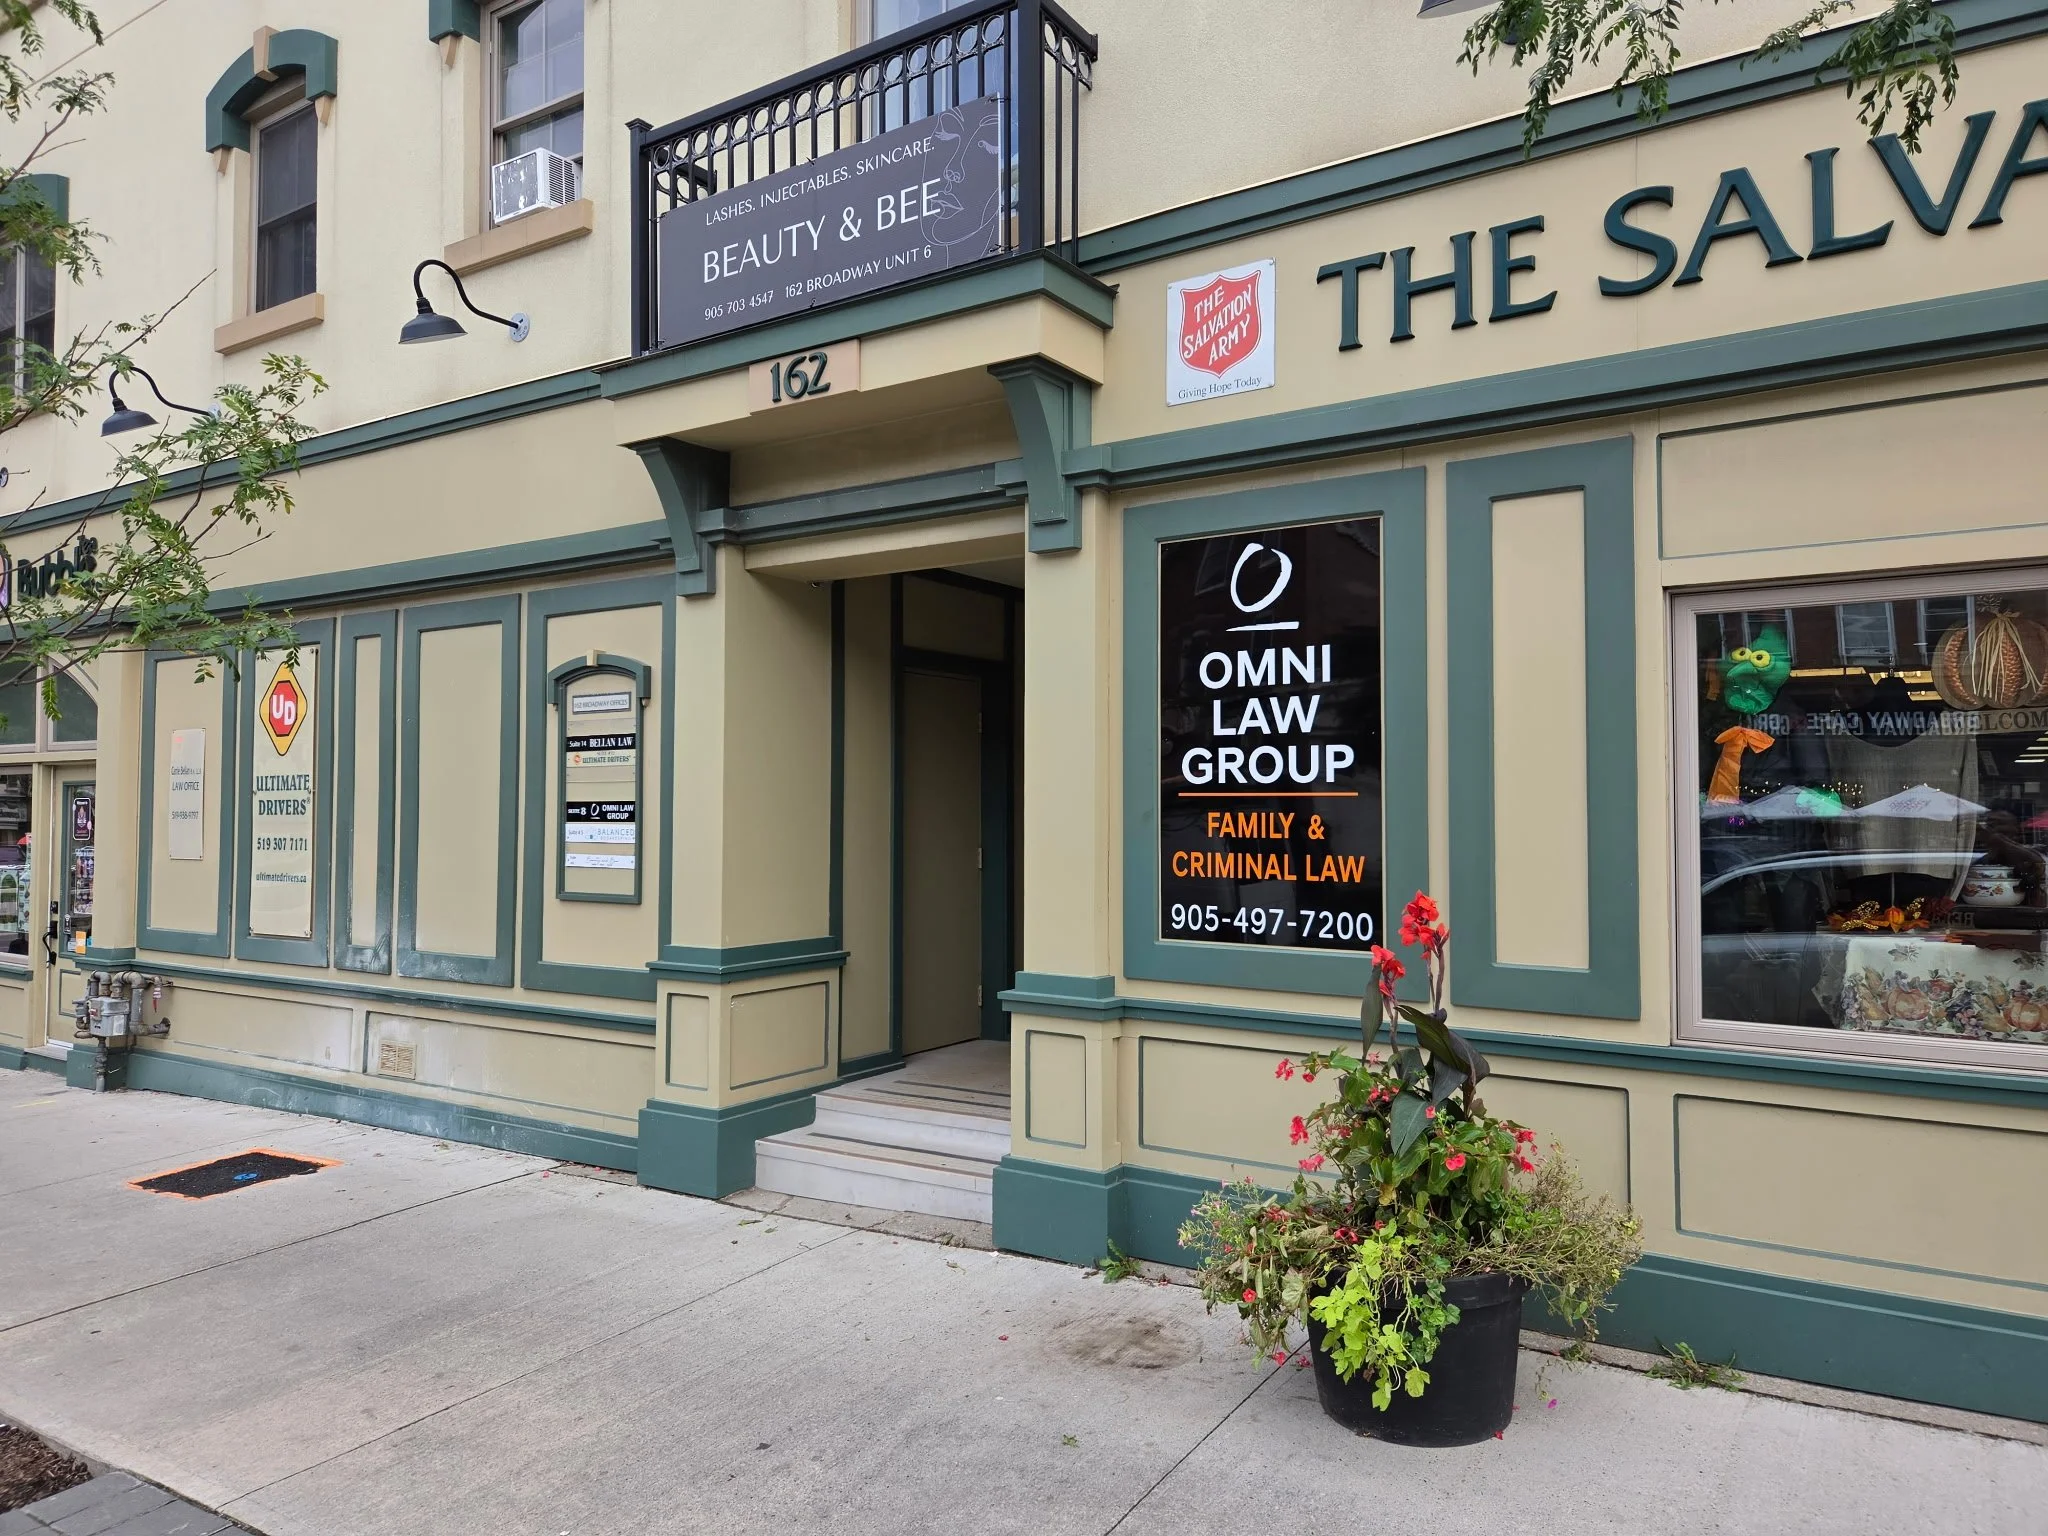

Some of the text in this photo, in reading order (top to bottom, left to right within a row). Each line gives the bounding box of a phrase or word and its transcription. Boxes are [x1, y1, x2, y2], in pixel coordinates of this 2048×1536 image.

[706, 136, 935, 226] LASHES. INJECTABLES. SKINCARE.
[703, 178, 941, 283] BEAUTY & BEE
[1316, 97, 2048, 352] THE SALVA
[704, 244, 932, 321] 905 703 4547 162 BROADWAY UNIT 6
[1194, 285, 1225, 323] THE
[1183, 284, 1252, 359] SALVATION
[1208, 313, 1250, 366] ARMY
[770, 351, 830, 402] 162
[1178, 376, 1262, 400] Giving Hope Today
[1199, 645, 1330, 689] OMNI
[272, 694, 296, 726] UD
[583, 700, 610, 708] BROADWAY
[1213, 695, 1320, 736] LAW
[589, 738, 616, 748] BELLAN
[618, 737, 634, 747] LAW
[583, 756, 606, 764] ULTIMATE
[1181, 745, 1355, 785] GROUP
[172, 781, 200, 791] LAW OFFICE
[256, 774, 310, 792] ULTIMATE
[580, 807, 587, 815] 8
[602, 804, 619, 812] OMNI
[620, 804, 634, 812] LAW
[607, 812, 629, 820] GROUP
[1207, 812, 1325, 839] FAMILY &
[257, 837, 308, 851] 519 307 7171
[597, 828, 635, 836] BALANCED
[256, 872, 307, 884] ultimatedrivers.ca
[1172, 851, 1365, 883] CRIMINAL LAW
[1171, 904, 1373, 941] 905-497-7200
